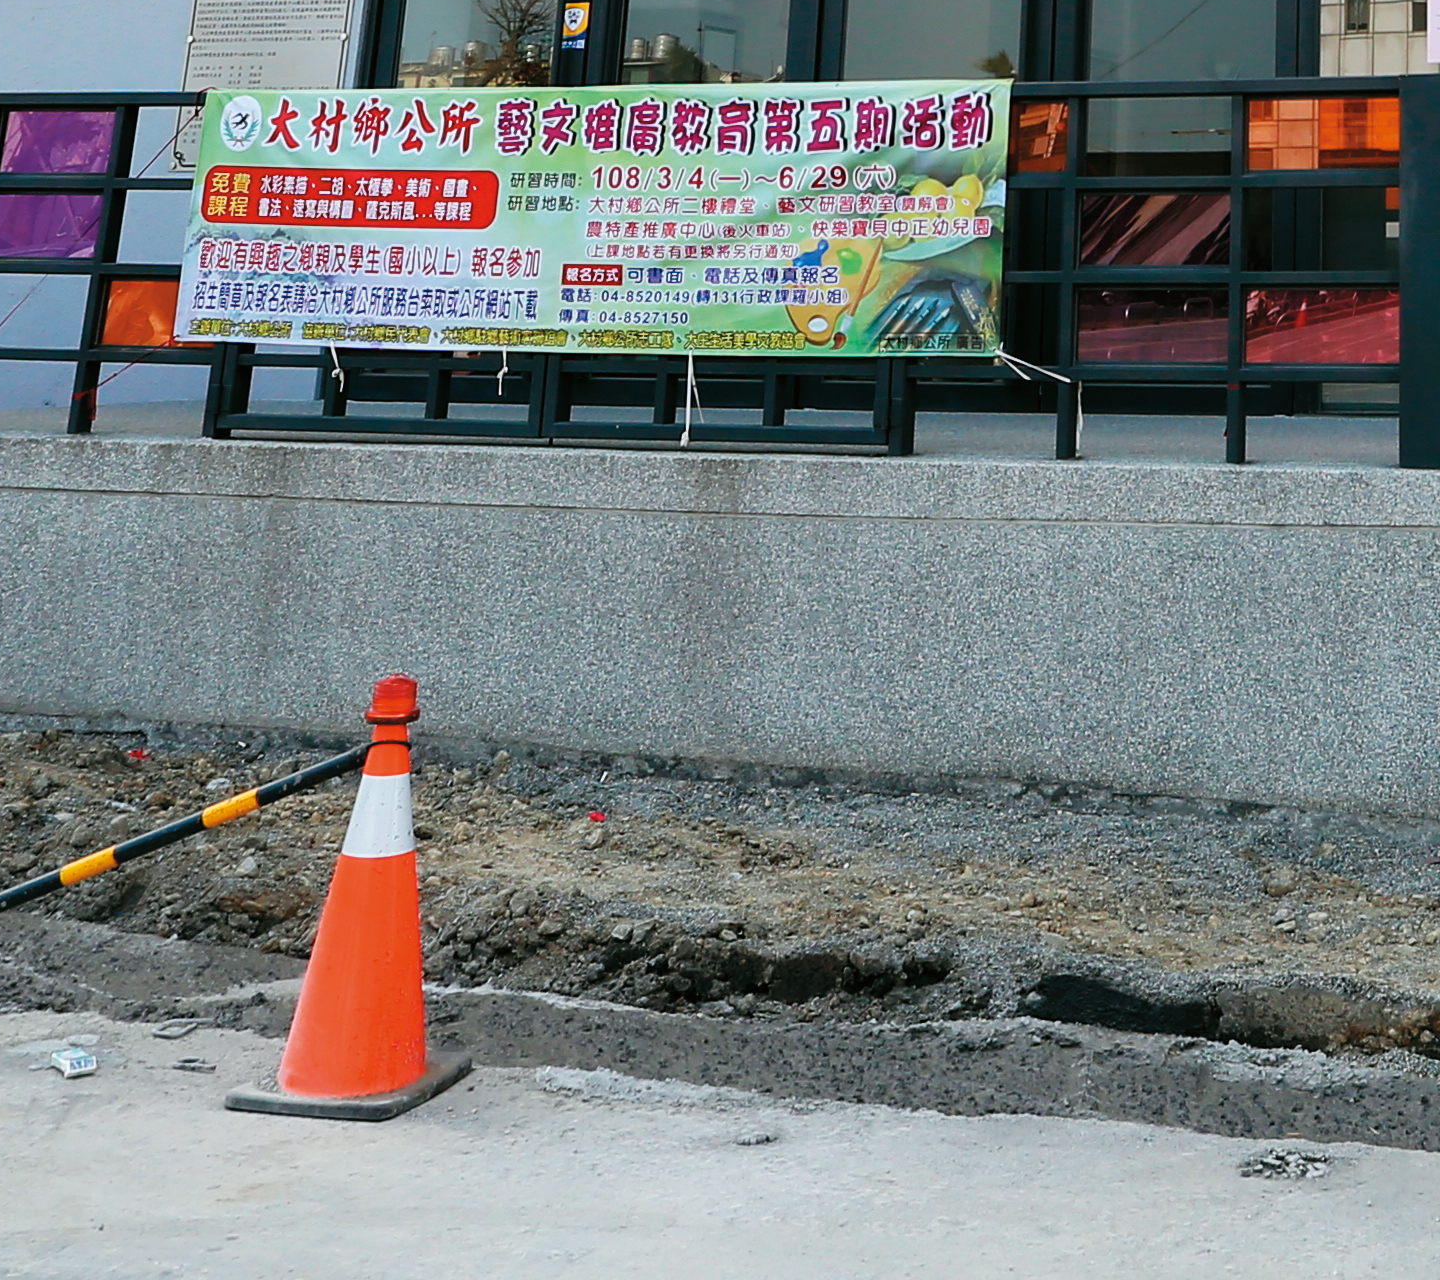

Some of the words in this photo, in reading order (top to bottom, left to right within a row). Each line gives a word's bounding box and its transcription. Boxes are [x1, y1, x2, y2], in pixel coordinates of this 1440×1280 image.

[264, 97, 481, 154] 大村鄉公所
[496, 94, 992, 155] 藝文推廣教育第五期活動
[210, 172, 251, 194] 免費
[207, 195, 249, 217] 課程
[471, 246, 541, 278] 報名參加
[565, 267, 620, 282] 報名方式
